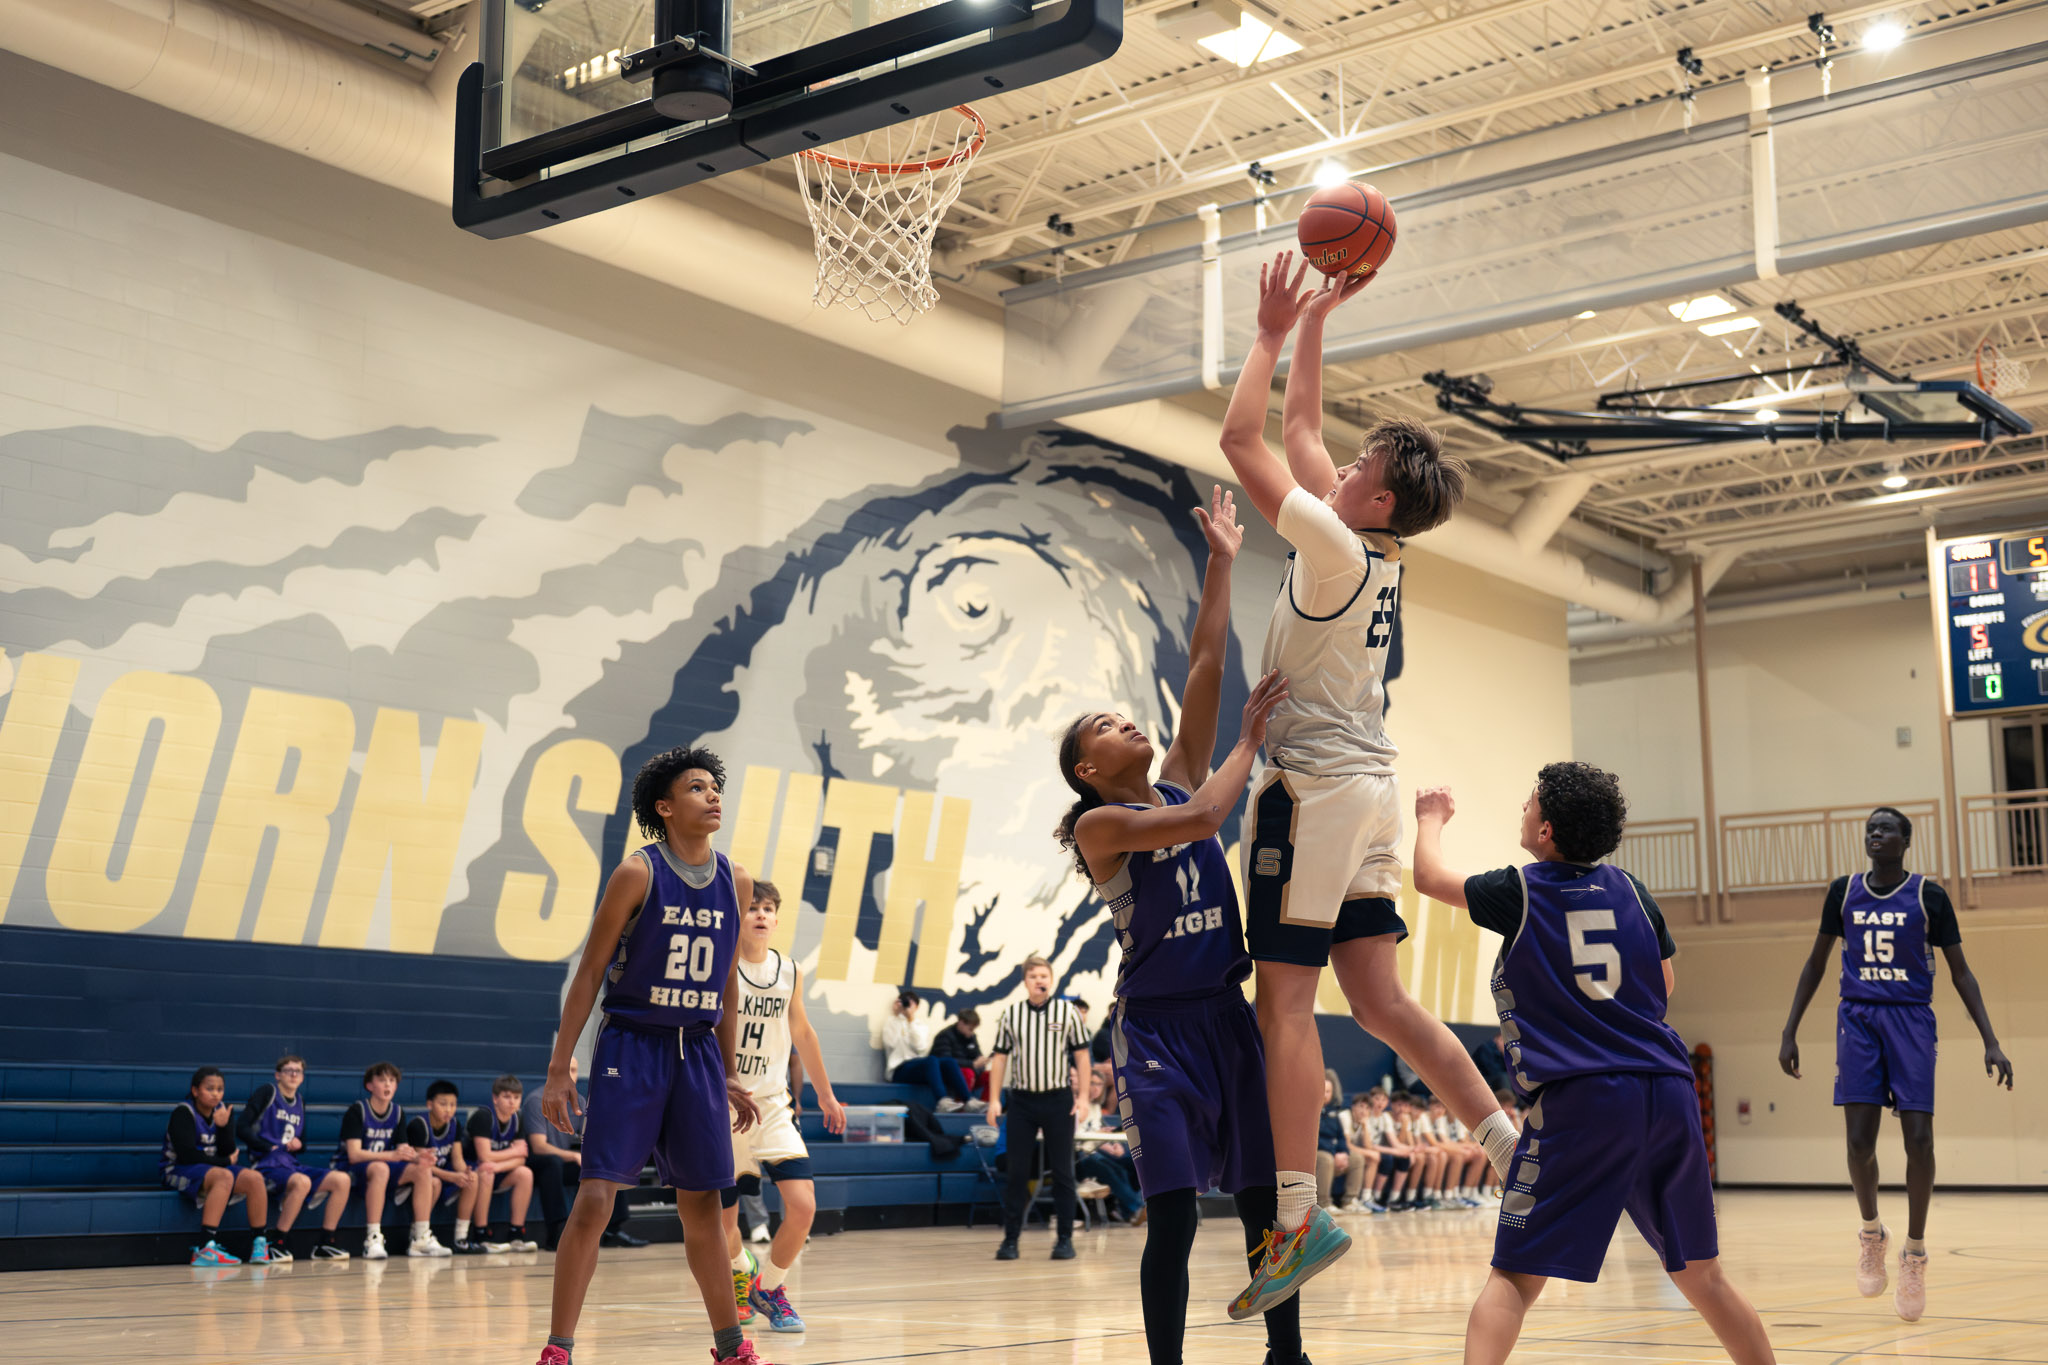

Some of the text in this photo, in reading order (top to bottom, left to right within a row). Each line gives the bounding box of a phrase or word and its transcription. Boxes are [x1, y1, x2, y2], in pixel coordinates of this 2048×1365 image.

[1969, 561, 1998, 592] 11
[1971, 624, 1988, 649] 5
[1968, 647, 1992, 661] LEFT
[1968, 662, 2002, 677] FOULS
[1985, 674, 2002, 699] 0
[495, 738, 972, 989] SUTH
[662, 905, 724, 929] EAST
[1163, 906, 1223, 939] IGH
[1852, 910, 1907, 926] EAST
[664, 934, 715, 982] 20
[1565, 909, 1622, 1000] 5
[1863, 930, 1895, 963] 15
[1859, 967, 1909, 982] HIGH
[650, 985, 719, 1011] HIGH
[738, 994, 788, 1018] KHORN
[741, 1021, 765, 1050] 14
[736, 1053, 770, 1076] OUTH
